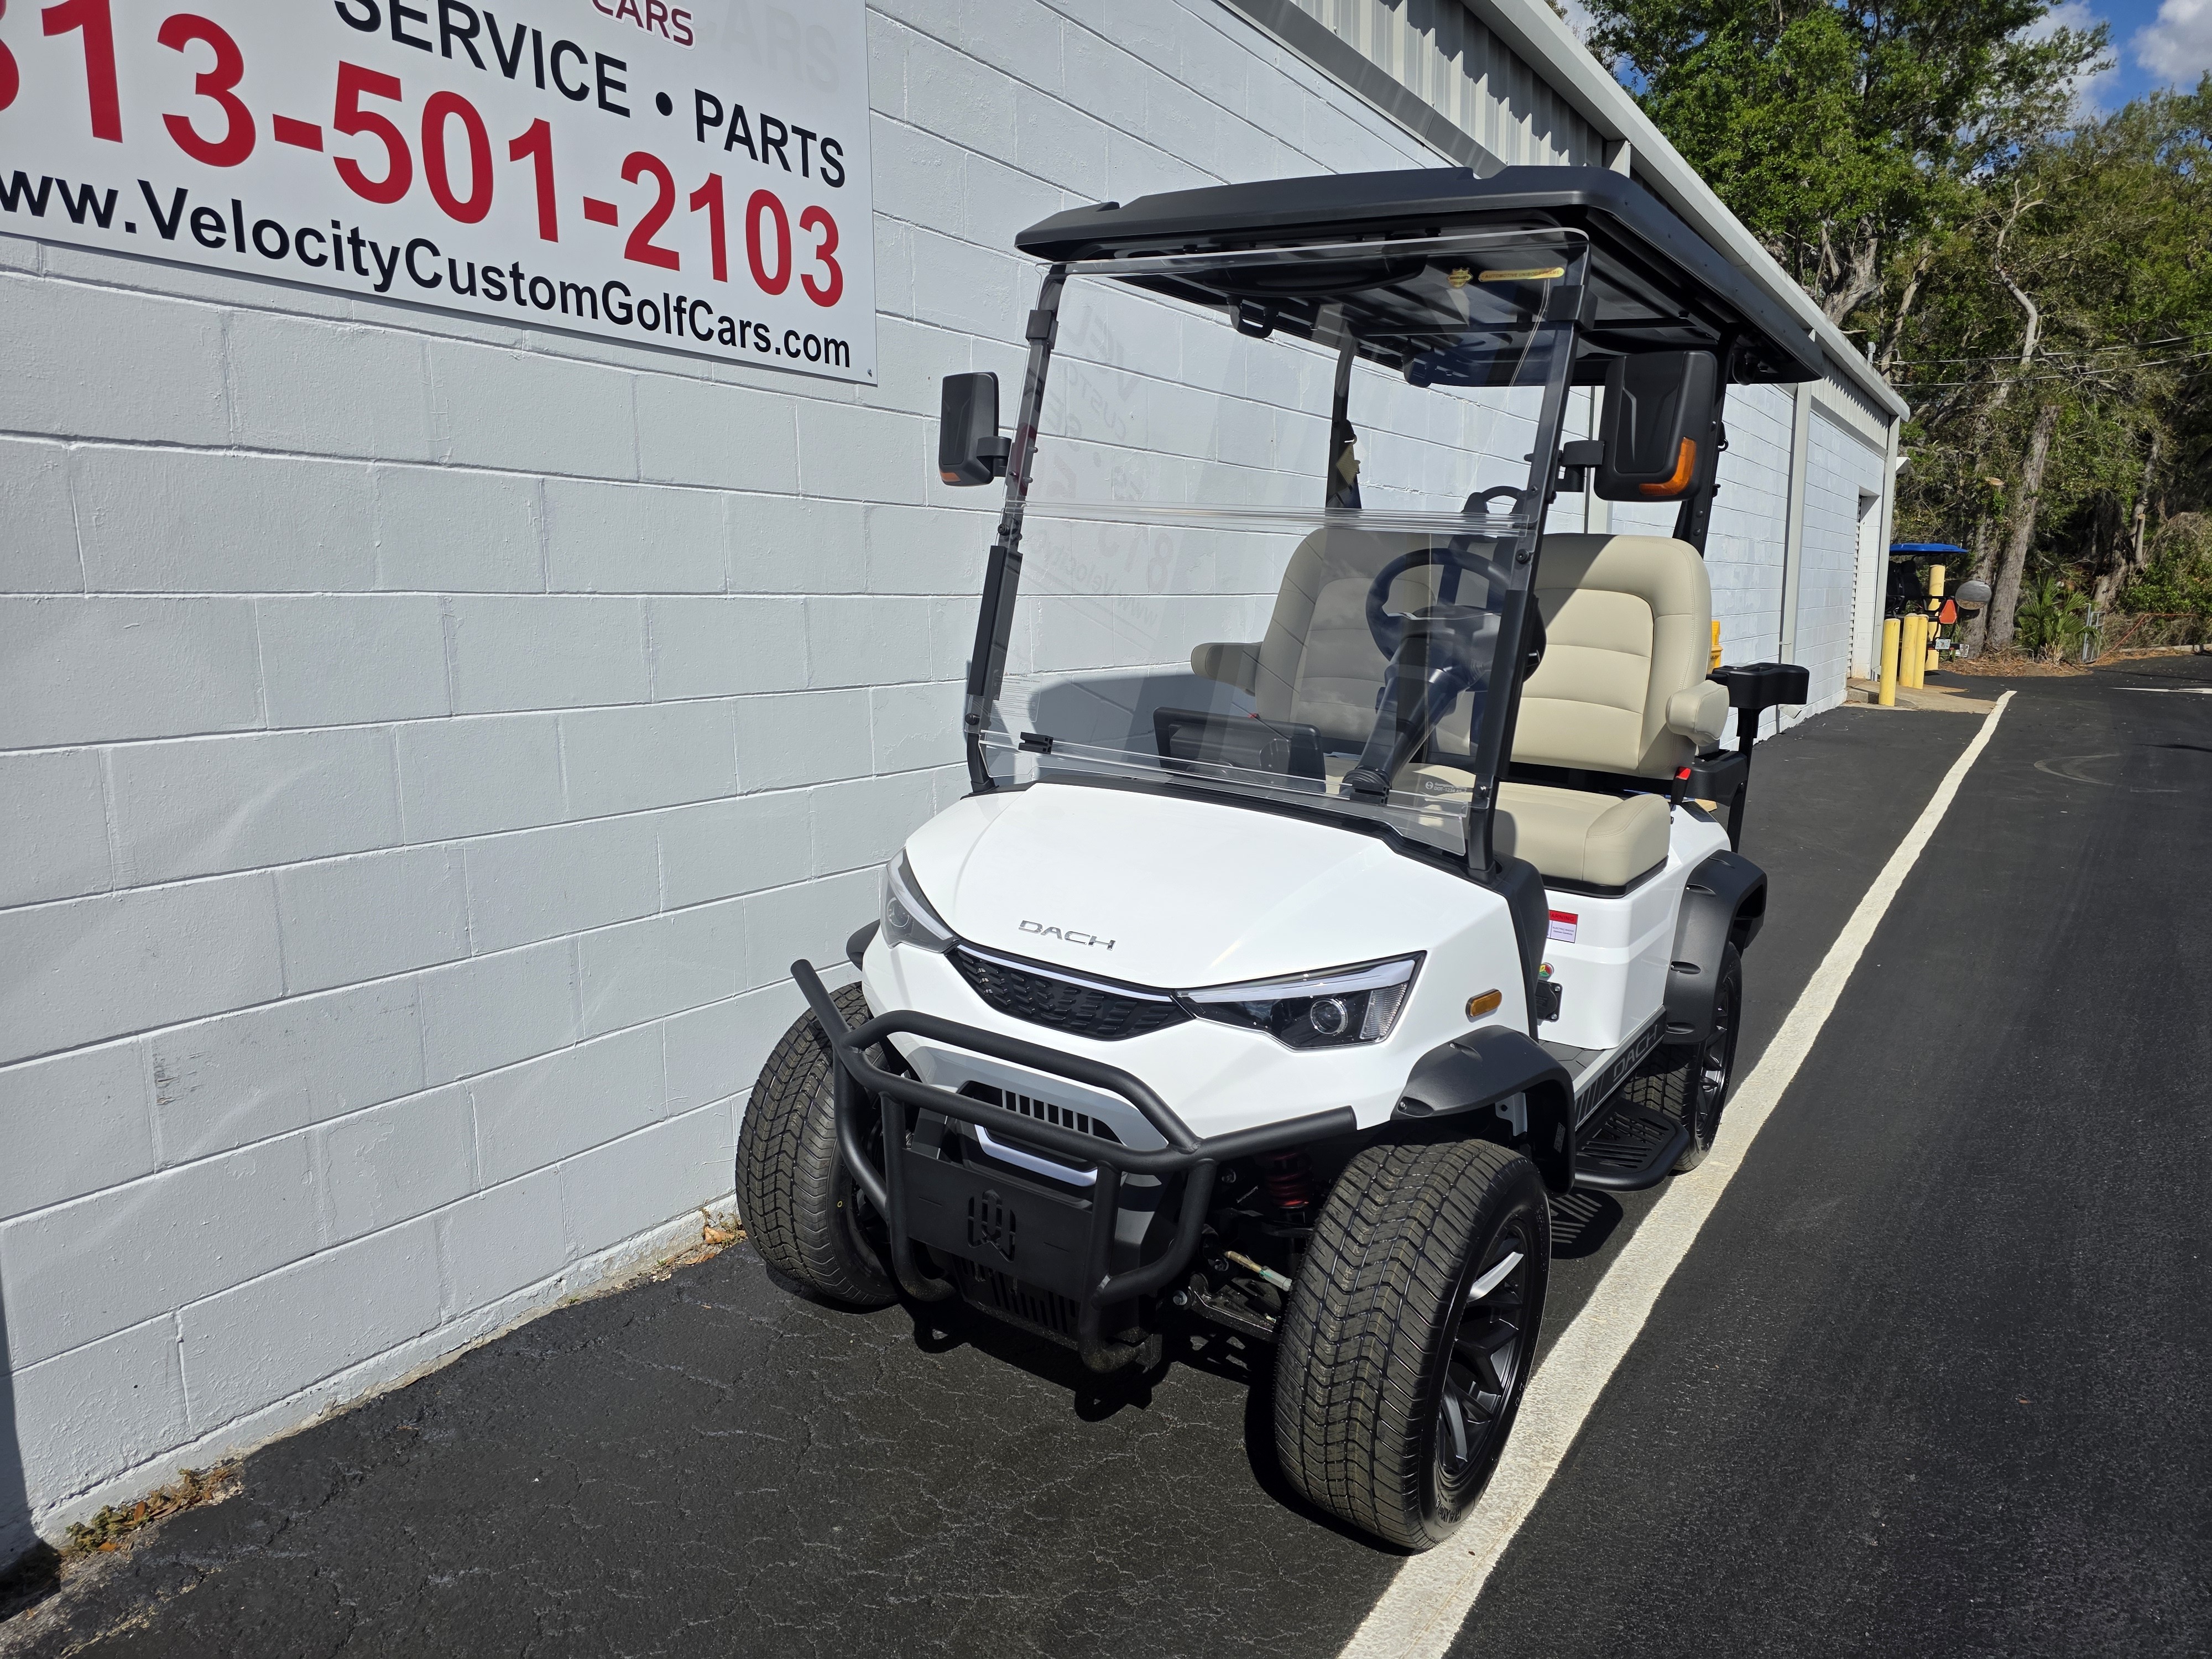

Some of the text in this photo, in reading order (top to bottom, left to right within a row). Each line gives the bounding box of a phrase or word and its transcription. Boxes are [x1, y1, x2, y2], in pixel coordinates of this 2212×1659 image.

[0, 0, 843, 307] 13-501-2103
[695, 88, 846, 187] PARTS
[1019, 920, 1116, 951] DACH
[1550, 912, 1575, 921] ARNING
[1613, 1024, 1658, 1082] DACH
